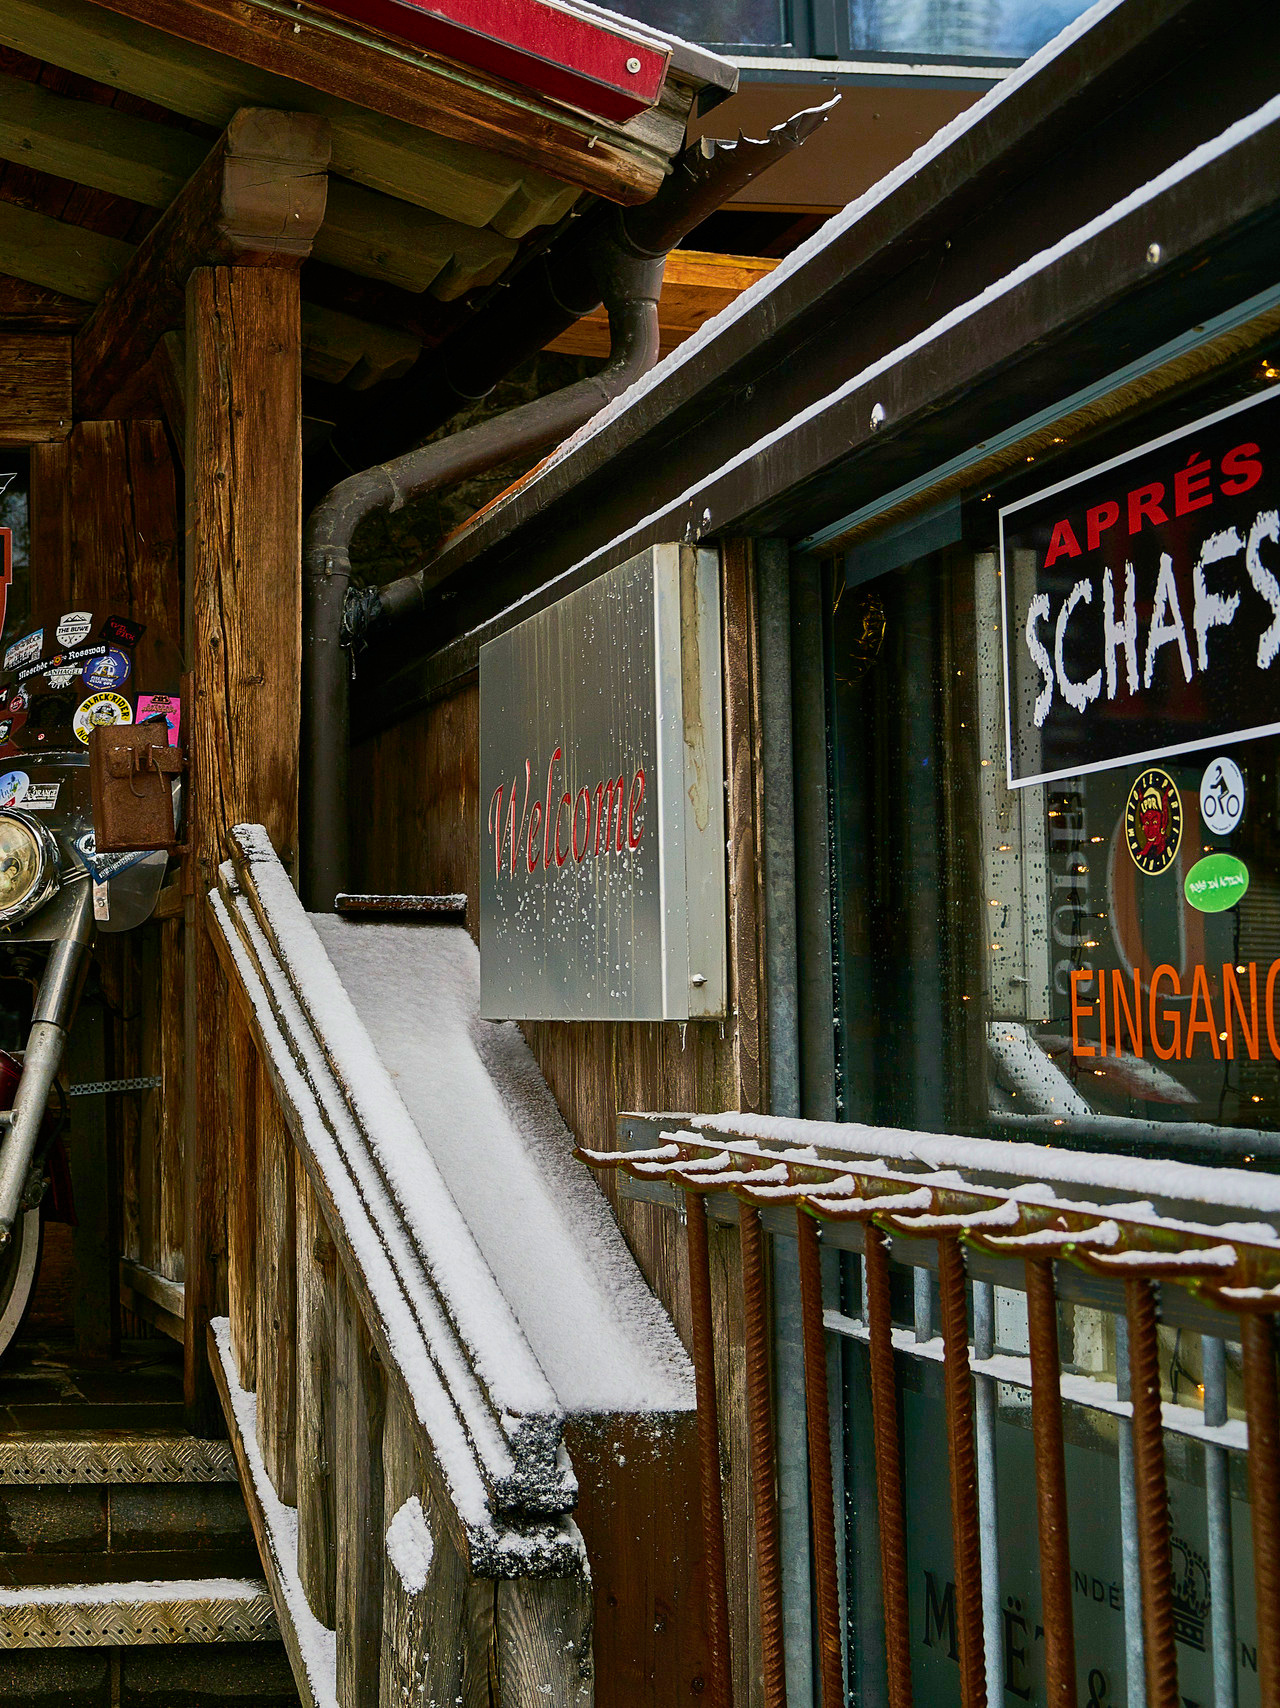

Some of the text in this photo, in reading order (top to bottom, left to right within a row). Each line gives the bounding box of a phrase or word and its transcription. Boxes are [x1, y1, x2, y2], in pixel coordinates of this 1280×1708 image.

[1043, 442, 1263, 568] APRÉS
[83, 693, 110, 711] BLACK
[112, 693, 130, 717] RIDER
[488, 747, 645, 881] Welcome
